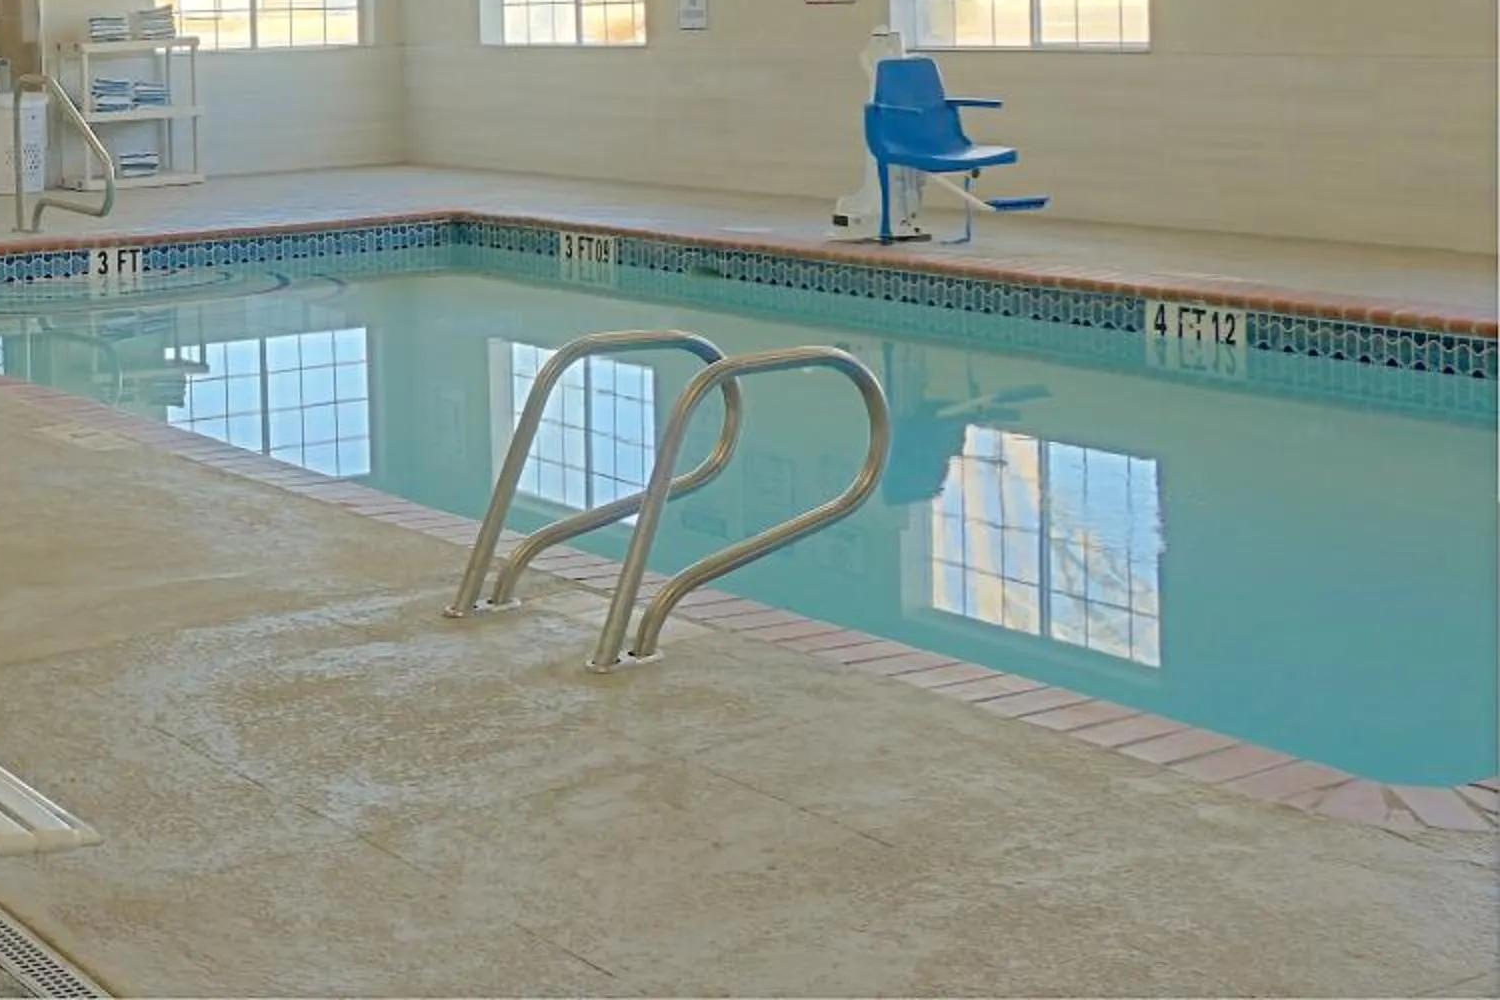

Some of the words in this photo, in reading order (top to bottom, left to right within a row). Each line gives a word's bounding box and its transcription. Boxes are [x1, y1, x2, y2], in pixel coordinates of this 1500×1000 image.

[97, 251, 109, 275] 3
[117, 249, 141, 273] FT
[1154, 303, 1168, 337] 4
